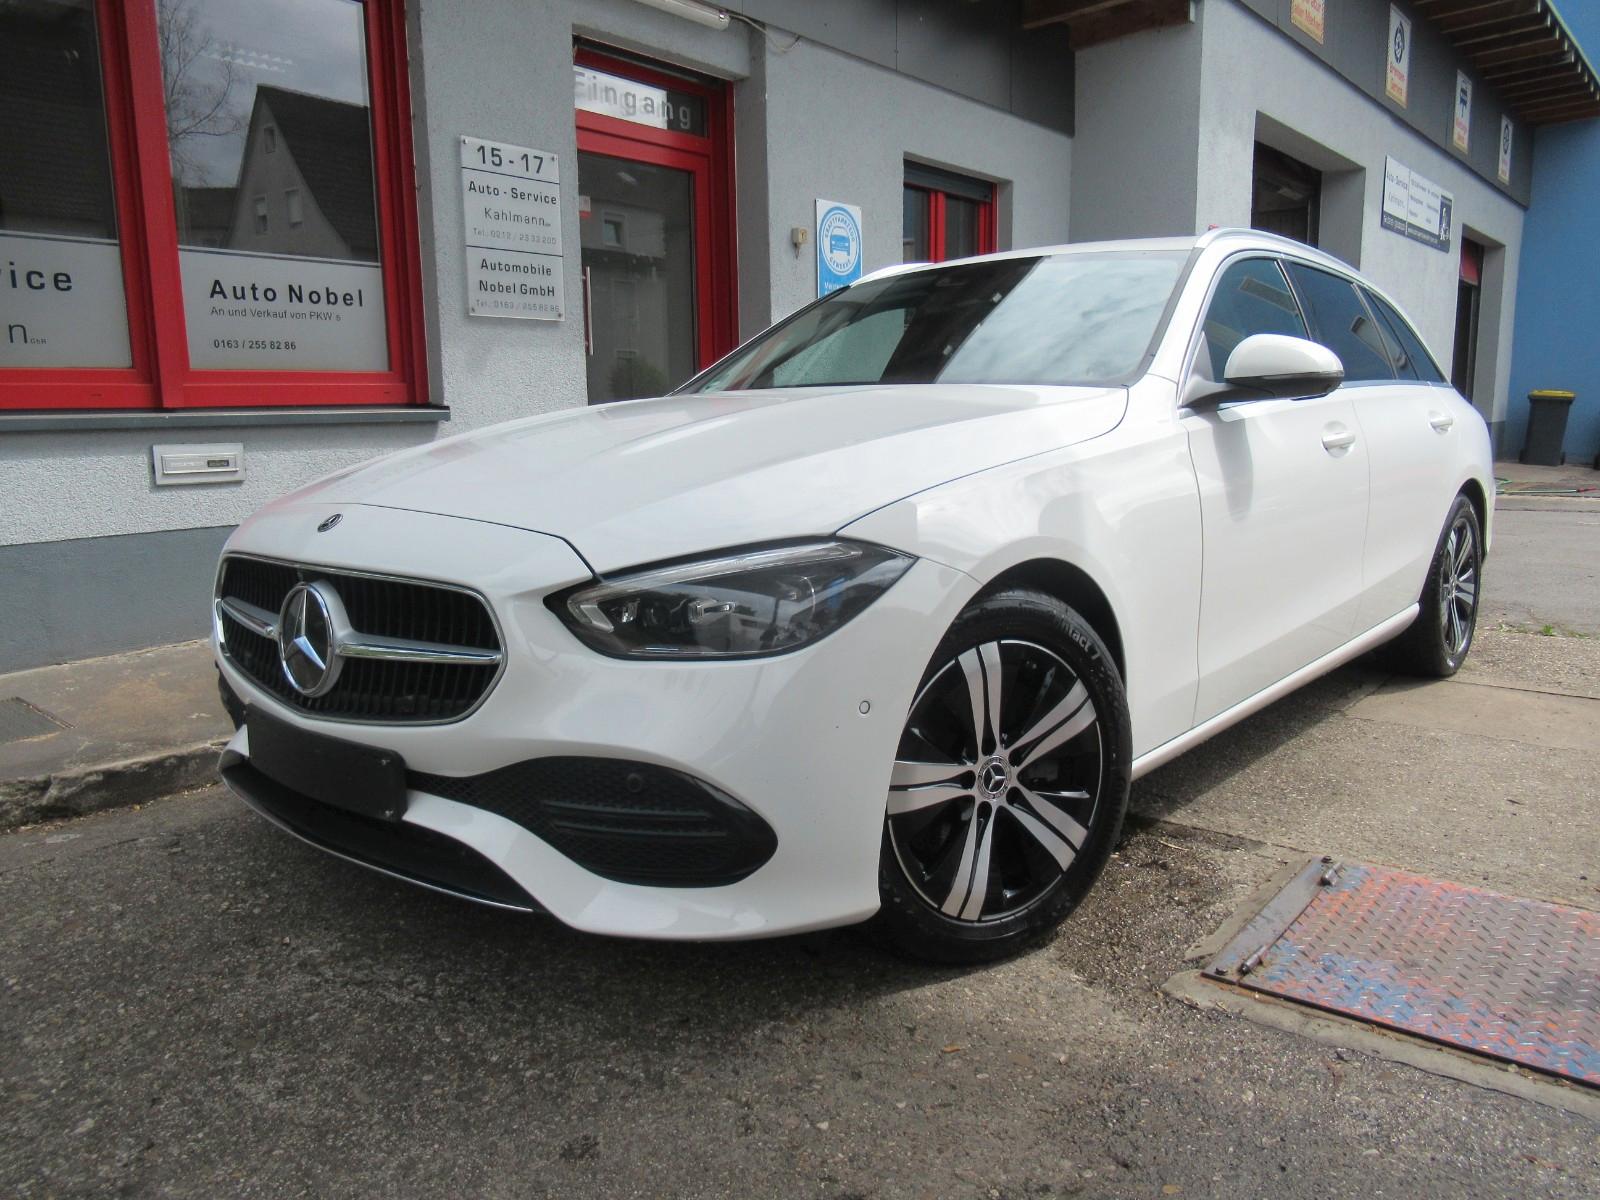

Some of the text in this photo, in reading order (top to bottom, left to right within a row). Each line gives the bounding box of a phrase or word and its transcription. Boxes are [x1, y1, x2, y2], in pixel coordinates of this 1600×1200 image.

[484, 207, 545, 227] Kahlmann
[480, 258, 552, 276] Automobile
[0, 261, 73, 292] ice
[209, 279, 363, 307] Auto Nobel
[479, 280, 555, 297] Nobel GmbH
[211, 306, 225, 317] An
[228, 307, 247, 317] und
[250, 308, 287, 319] Verkauf
[290, 311, 307, 320] von
[213, 339, 239, 349] 0163
[248, 340, 267, 350] 255
[270, 341, 282, 350] 82
[284, 341, 297, 351] 86
